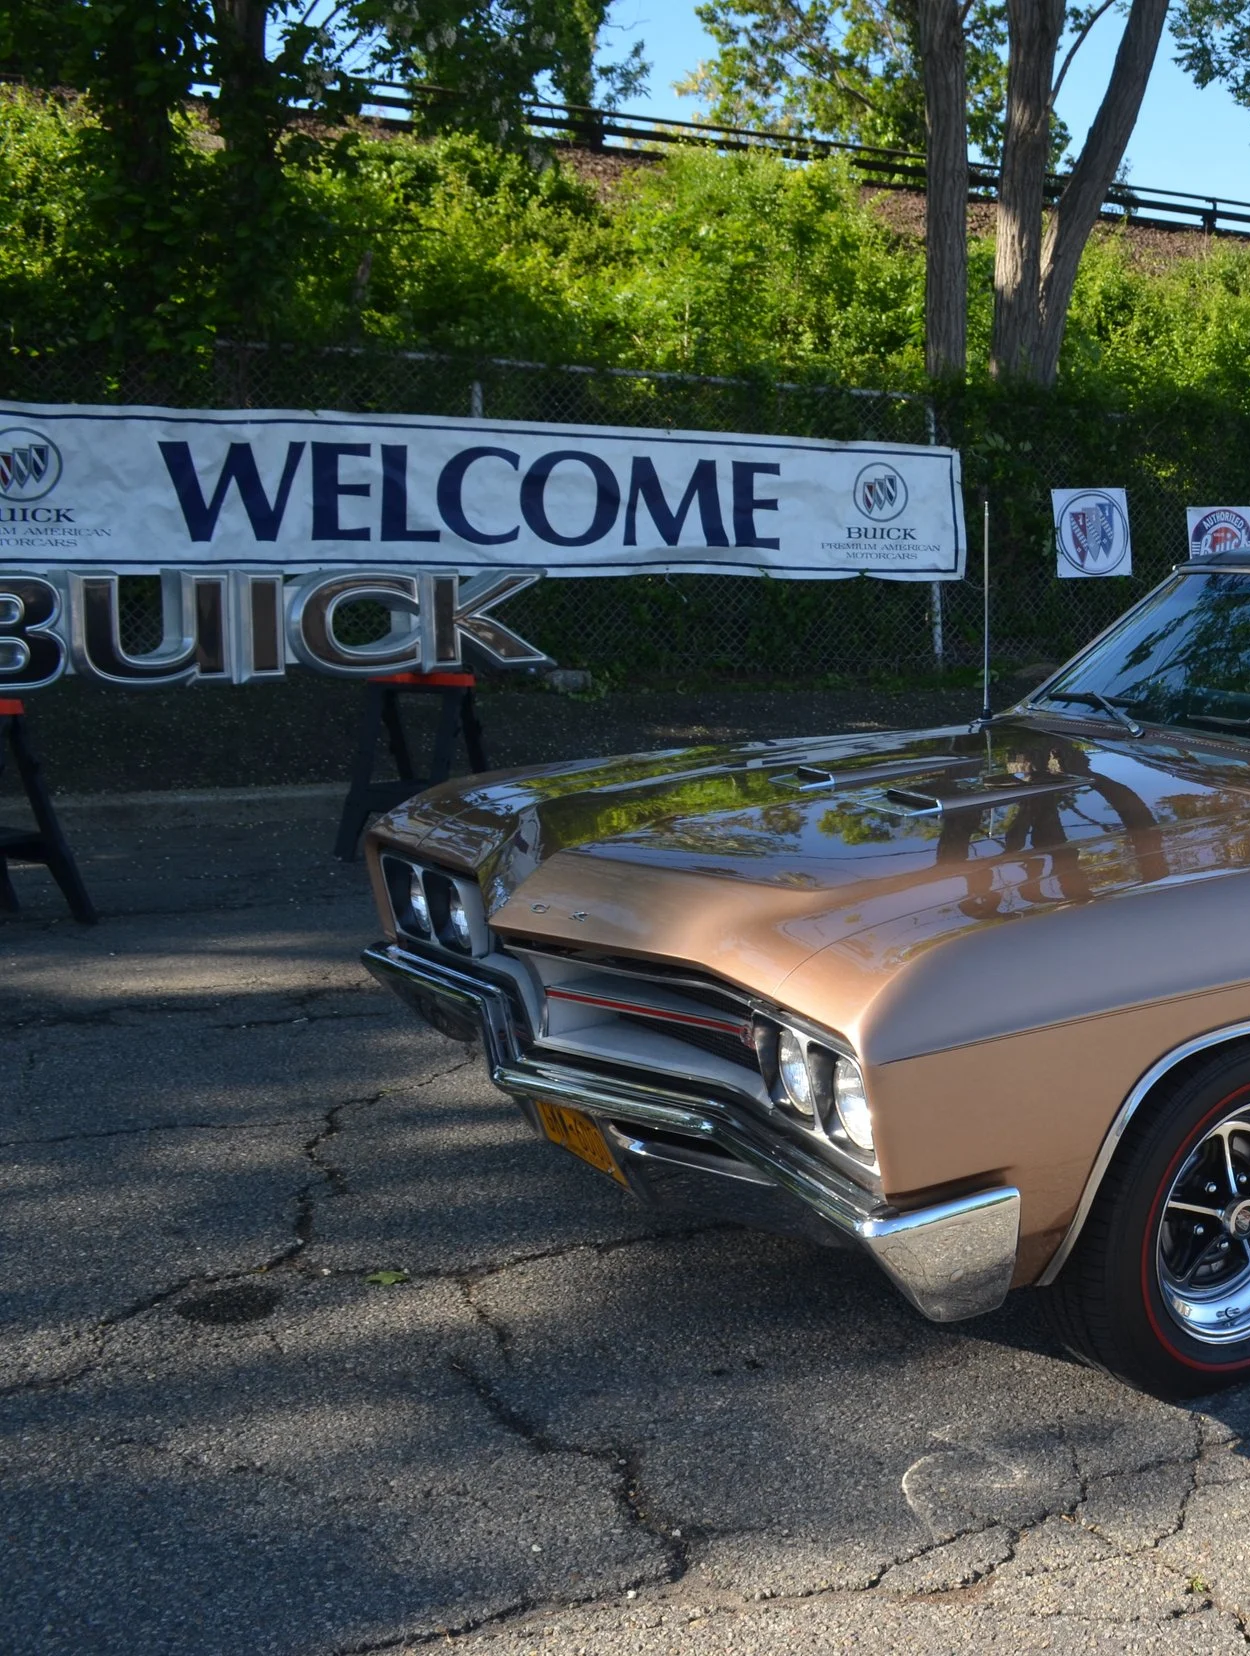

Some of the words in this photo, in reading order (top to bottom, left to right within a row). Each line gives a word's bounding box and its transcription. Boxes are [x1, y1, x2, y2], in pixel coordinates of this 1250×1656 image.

[157, 440, 782, 551] WELCOME
[1202, 511, 1244, 530] AUTHORIZED
[24, 527, 112, 537] AMERICAN
[845, 526, 918, 541] BUICK
[821, 542, 877, 551] PREMIUM
[881, 543, 941, 552] AMERICAN
[846, 551, 918, 560] MOTORCARS
